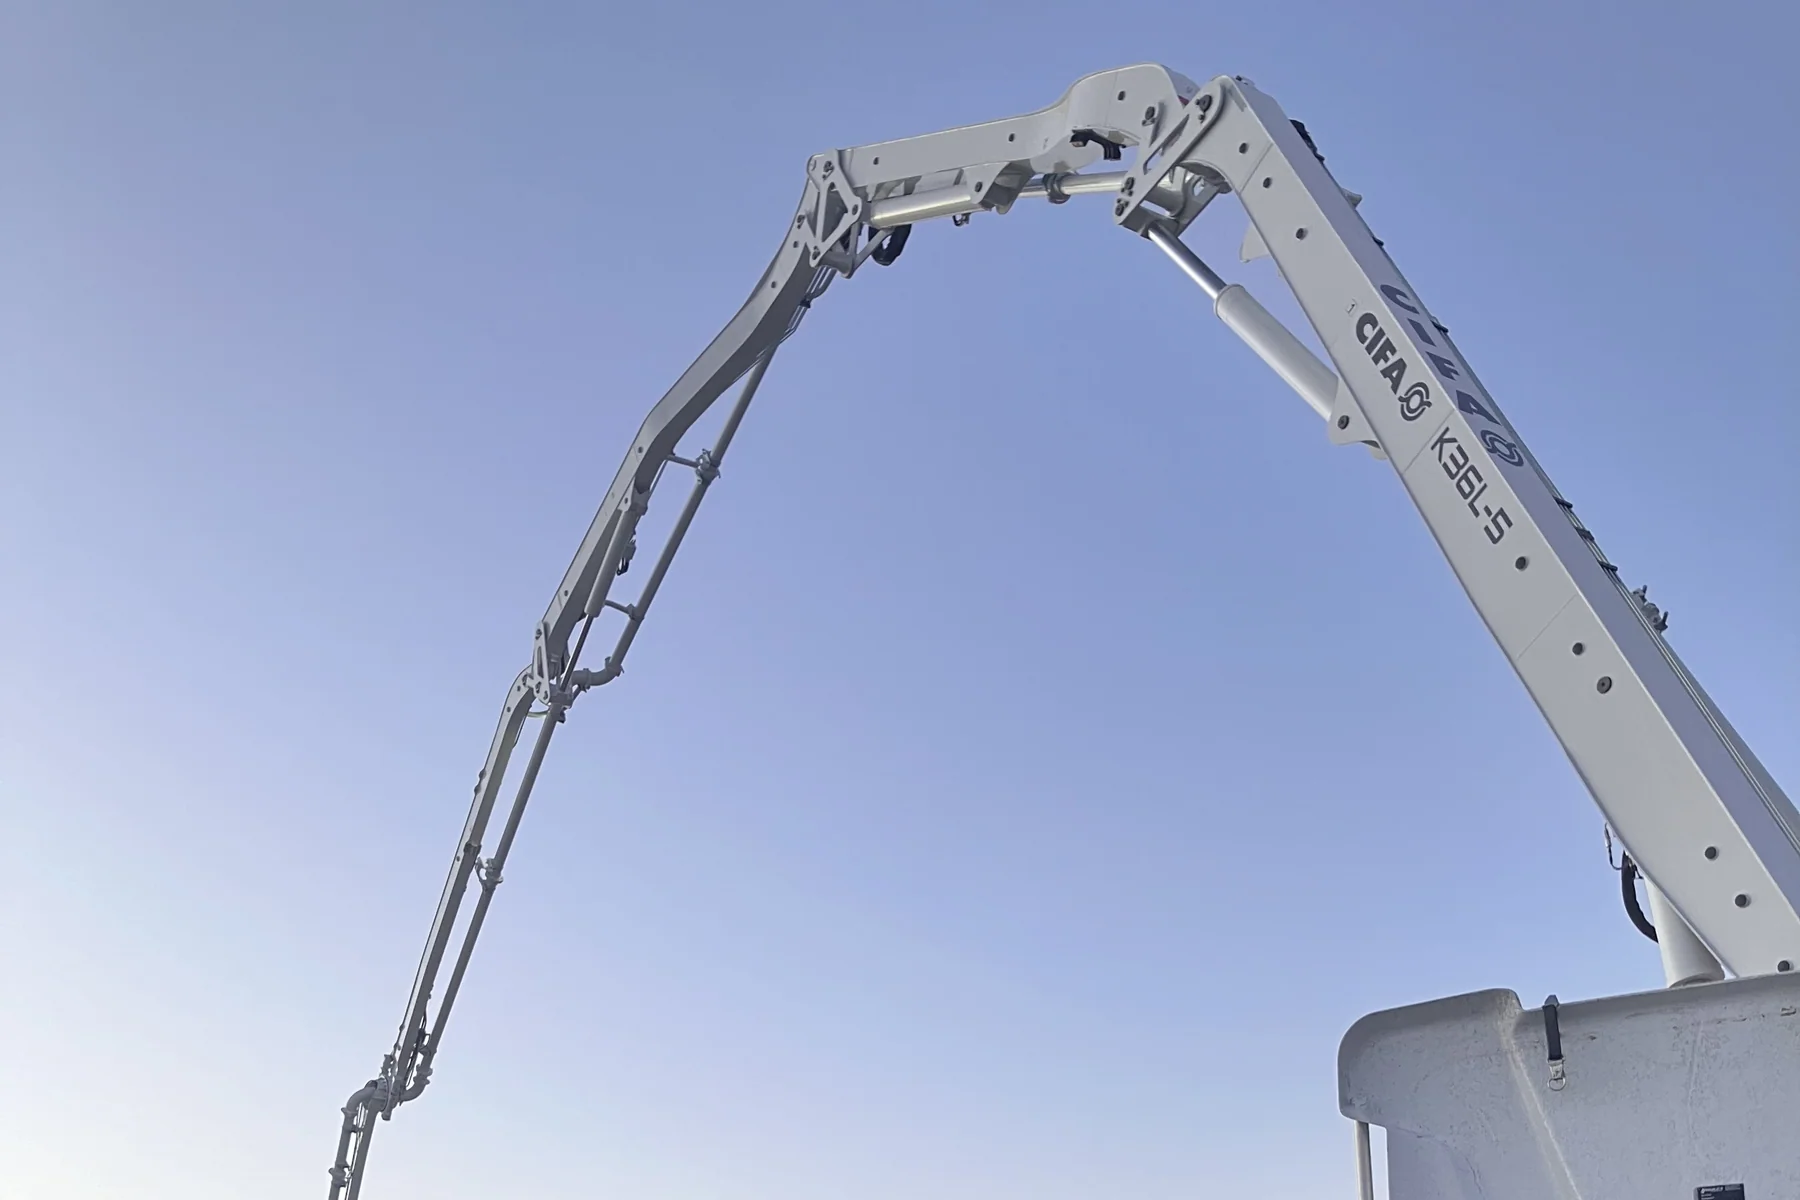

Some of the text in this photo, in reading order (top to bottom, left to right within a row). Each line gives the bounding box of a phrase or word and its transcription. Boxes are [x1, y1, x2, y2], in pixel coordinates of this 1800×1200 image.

[1355, 312, 1408, 396] CIFA
[1380, 284, 1501, 426] CIFA
[1430, 426, 1514, 545] K36L-5
